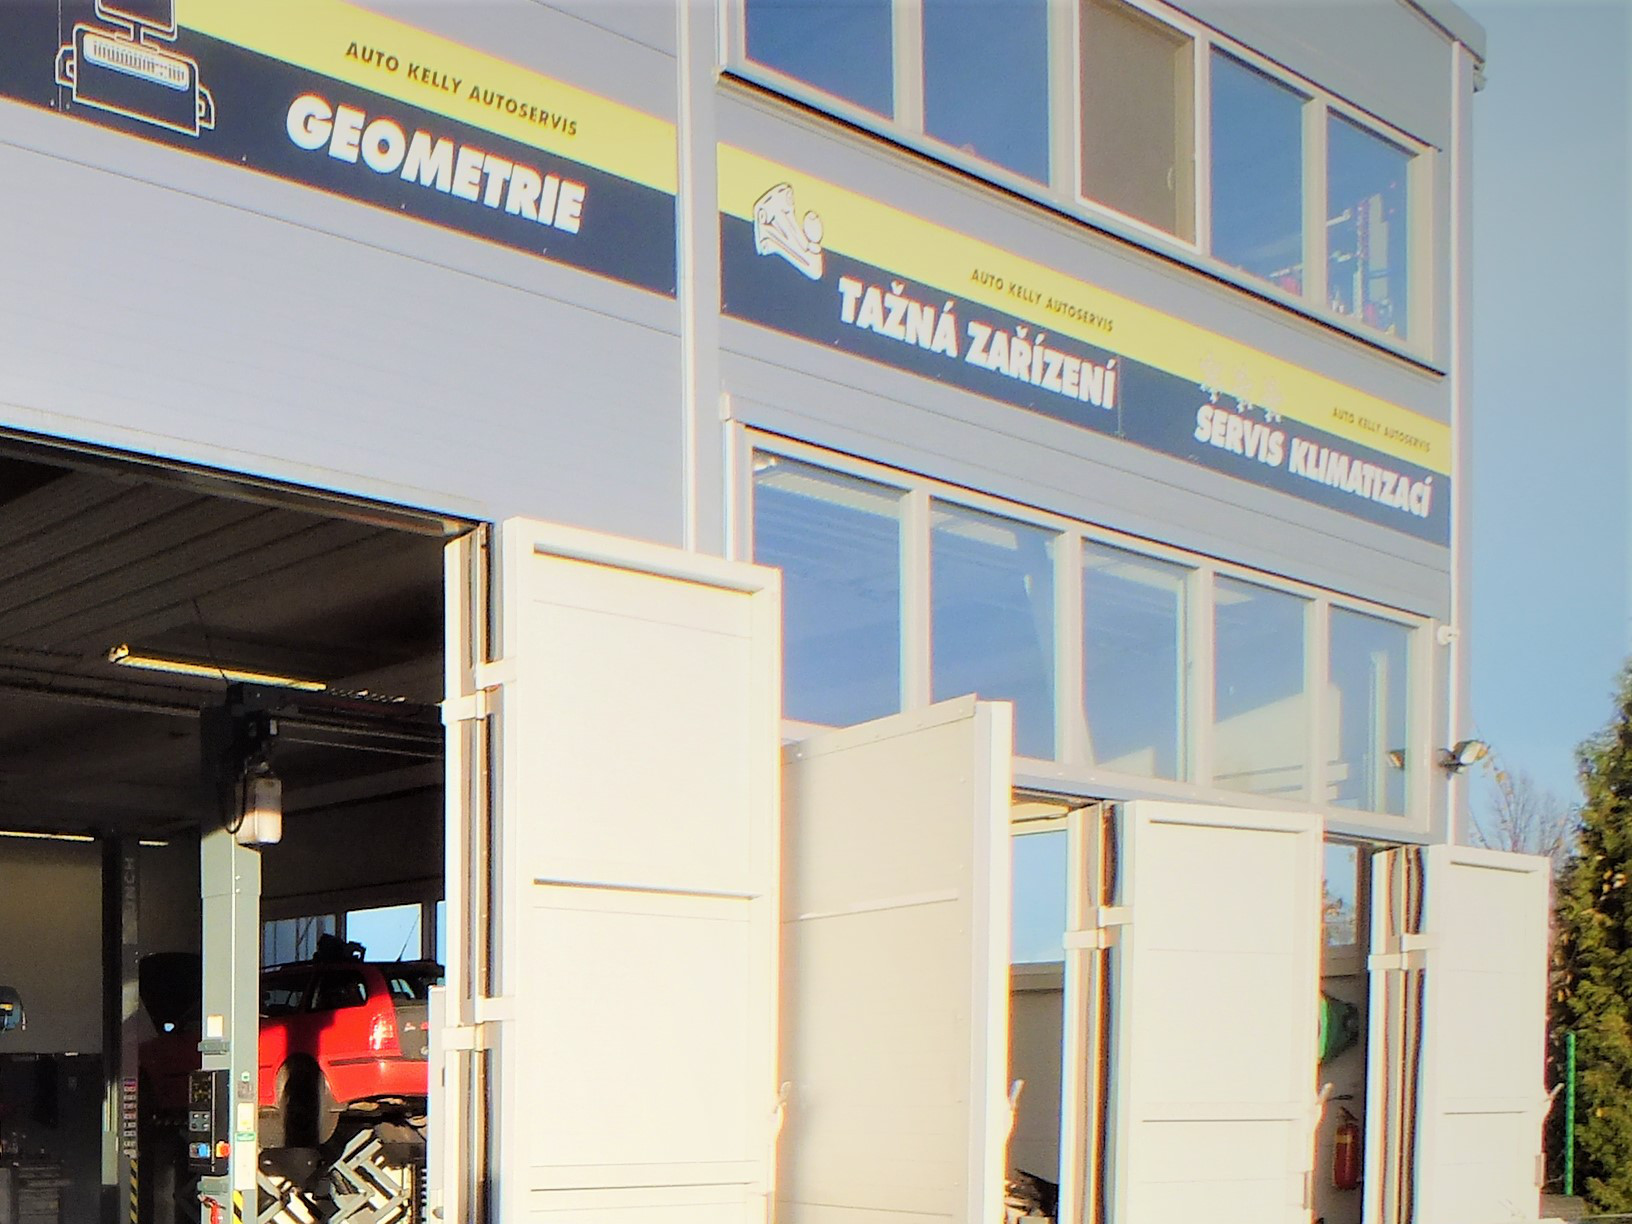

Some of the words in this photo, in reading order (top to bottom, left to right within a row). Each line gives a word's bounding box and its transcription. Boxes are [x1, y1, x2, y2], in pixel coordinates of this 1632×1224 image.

[344, 41, 400, 72] AUTO
[407, 62, 463, 94] KELLY
[468, 85, 579, 137] AUTOSERVIS
[285, 94, 587, 235] GEOMETRIE
[837, 276, 959, 358] TAŽNÁ
[964, 320, 1118, 410] ZAŘÍZENÍ
[970, 268, 1005, 291] AUTO
[1008, 280, 1043, 305] KELLY
[1045, 298, 1115, 332] AUTOSERVIS
[1194, 404, 1286, 468] SERVIS
[1288, 437, 1433, 519] KLIMATIZACÍ
[1331, 407, 1355, 425] AUTO
